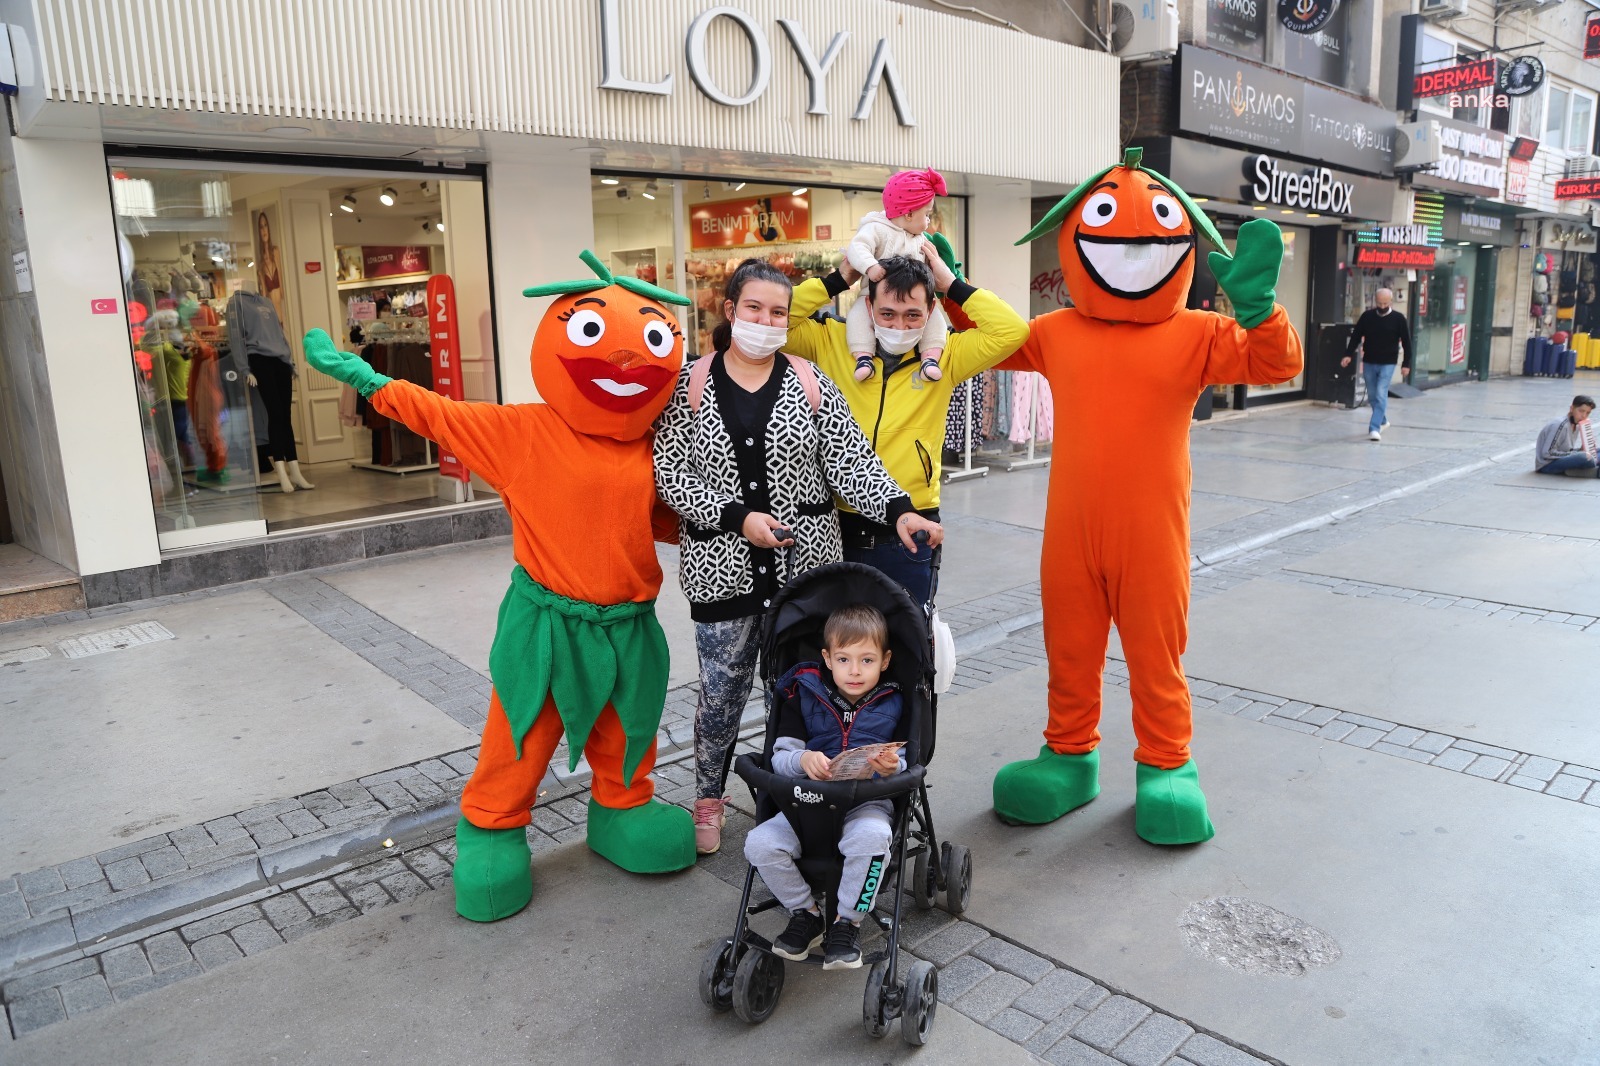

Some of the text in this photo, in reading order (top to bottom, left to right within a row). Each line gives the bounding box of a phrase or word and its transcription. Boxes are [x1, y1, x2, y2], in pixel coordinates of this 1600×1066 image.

[1283, 8, 1328, 31] EQUIPMENT
[597, 0, 917, 127] LOYA
[1192, 70, 1296, 124] PANORMOS
[1309, 114, 1350, 141] TATTOO
[1367, 130, 1392, 153] BULL
[1441, 127, 1461, 150] AST
[1252, 154, 1354, 214] StreetBox
[1558, 183, 1591, 195] KIRIK
[793, 786, 824, 802] Baby
[856, 861, 882, 912] MOVE
